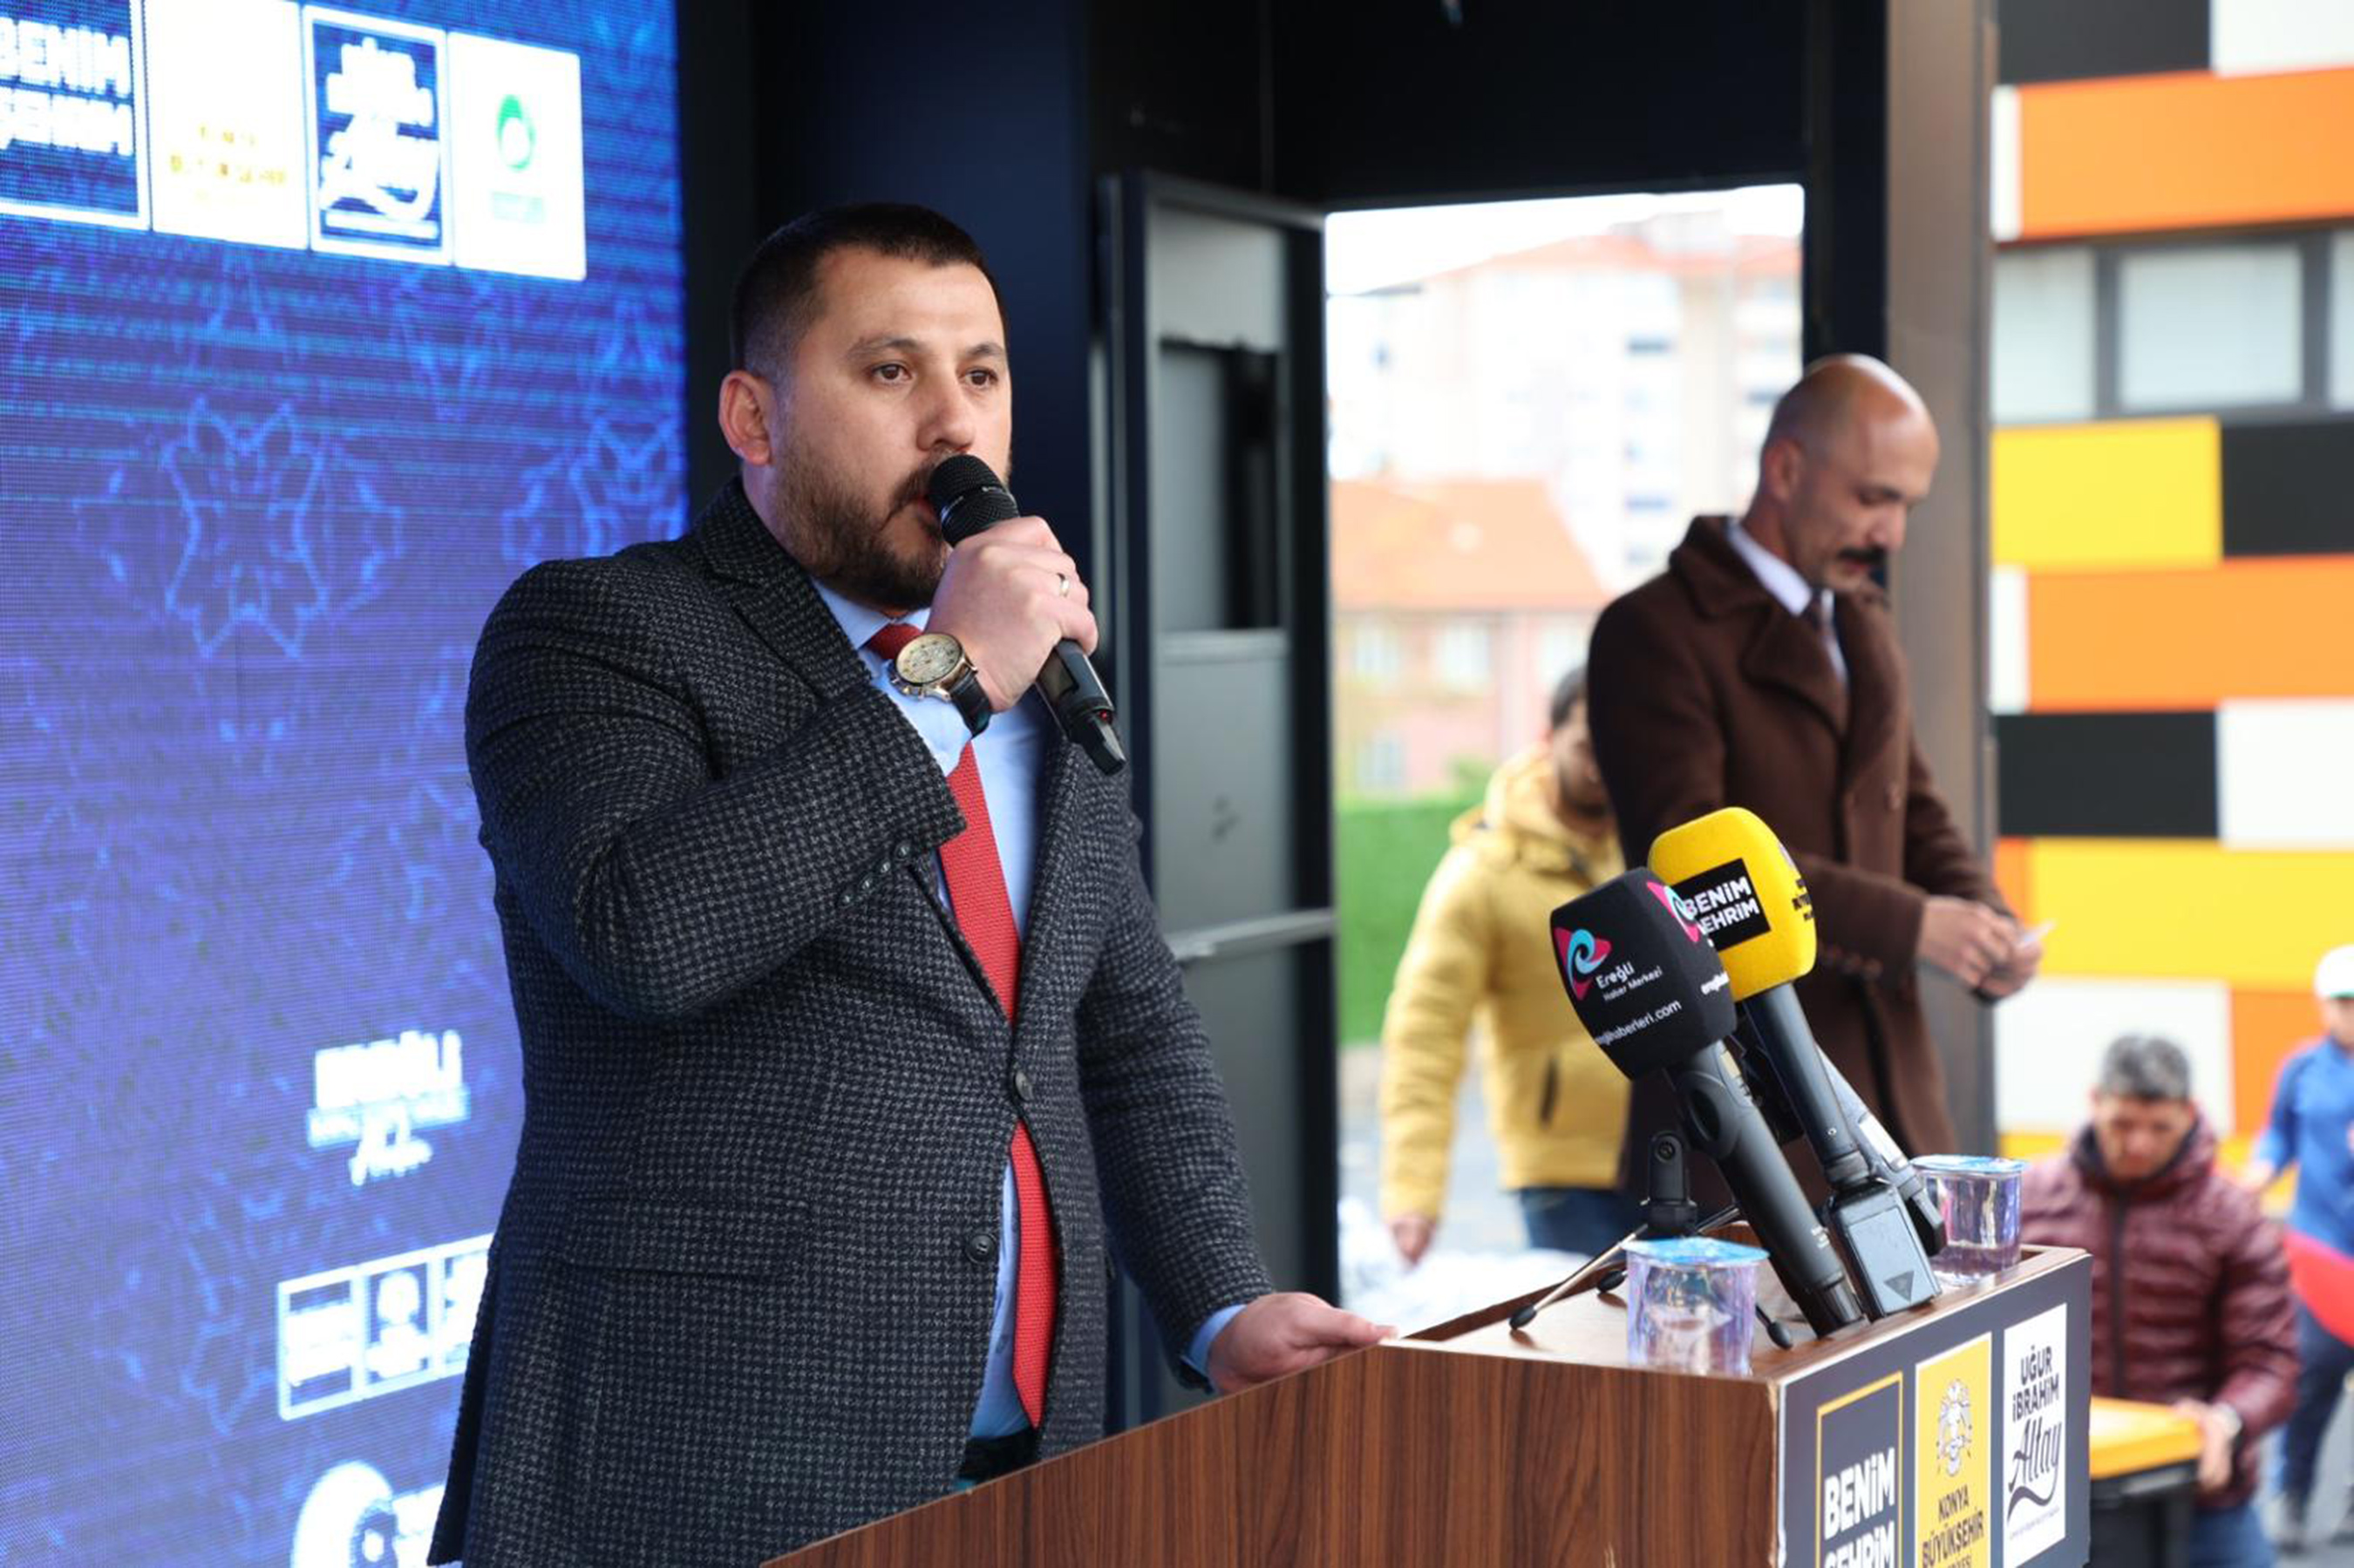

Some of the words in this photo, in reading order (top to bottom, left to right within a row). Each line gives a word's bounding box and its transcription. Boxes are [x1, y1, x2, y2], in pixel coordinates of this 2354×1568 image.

[1697, 898, 1759, 936] EHRİM
[1595, 961, 1636, 989] Ereğli
[1627, 965, 1663, 990] Merkezi
[2020, 1345, 2052, 1386] UĞUR
[2006, 1415, 2062, 1525] Altay
[1824, 1447, 1895, 1539] BENİM
[1938, 1484, 1969, 1522] KONYA
[1825, 1521, 1895, 1568] HRİM
